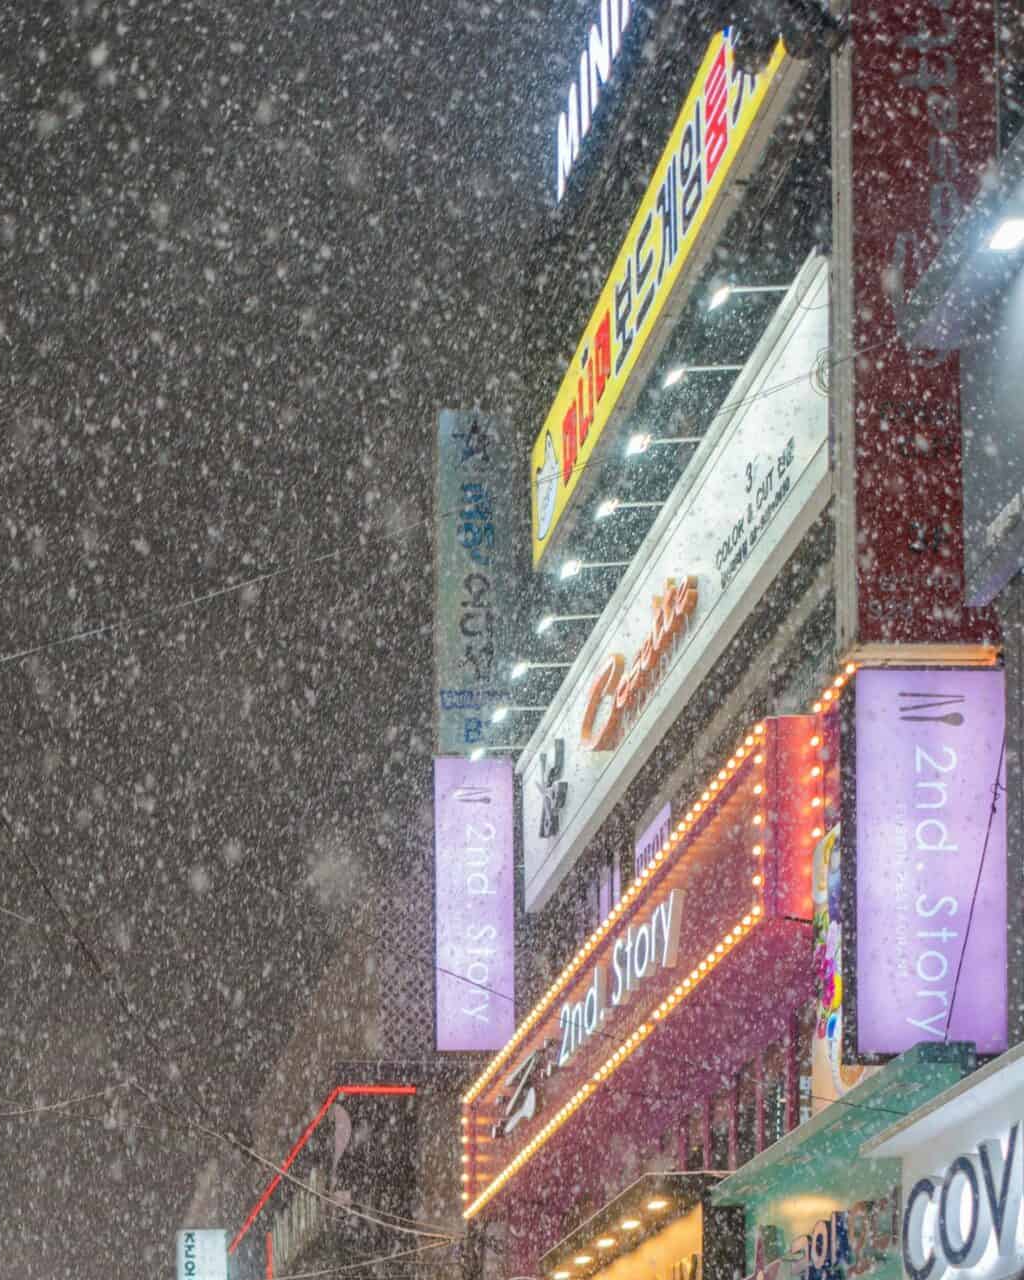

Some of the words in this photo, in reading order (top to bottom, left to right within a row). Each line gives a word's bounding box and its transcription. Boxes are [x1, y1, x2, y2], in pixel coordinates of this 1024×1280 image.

[462, 923, 497, 1023] Story
[611, 888, 675, 1006] Story
[905, 892, 960, 1040] Story
